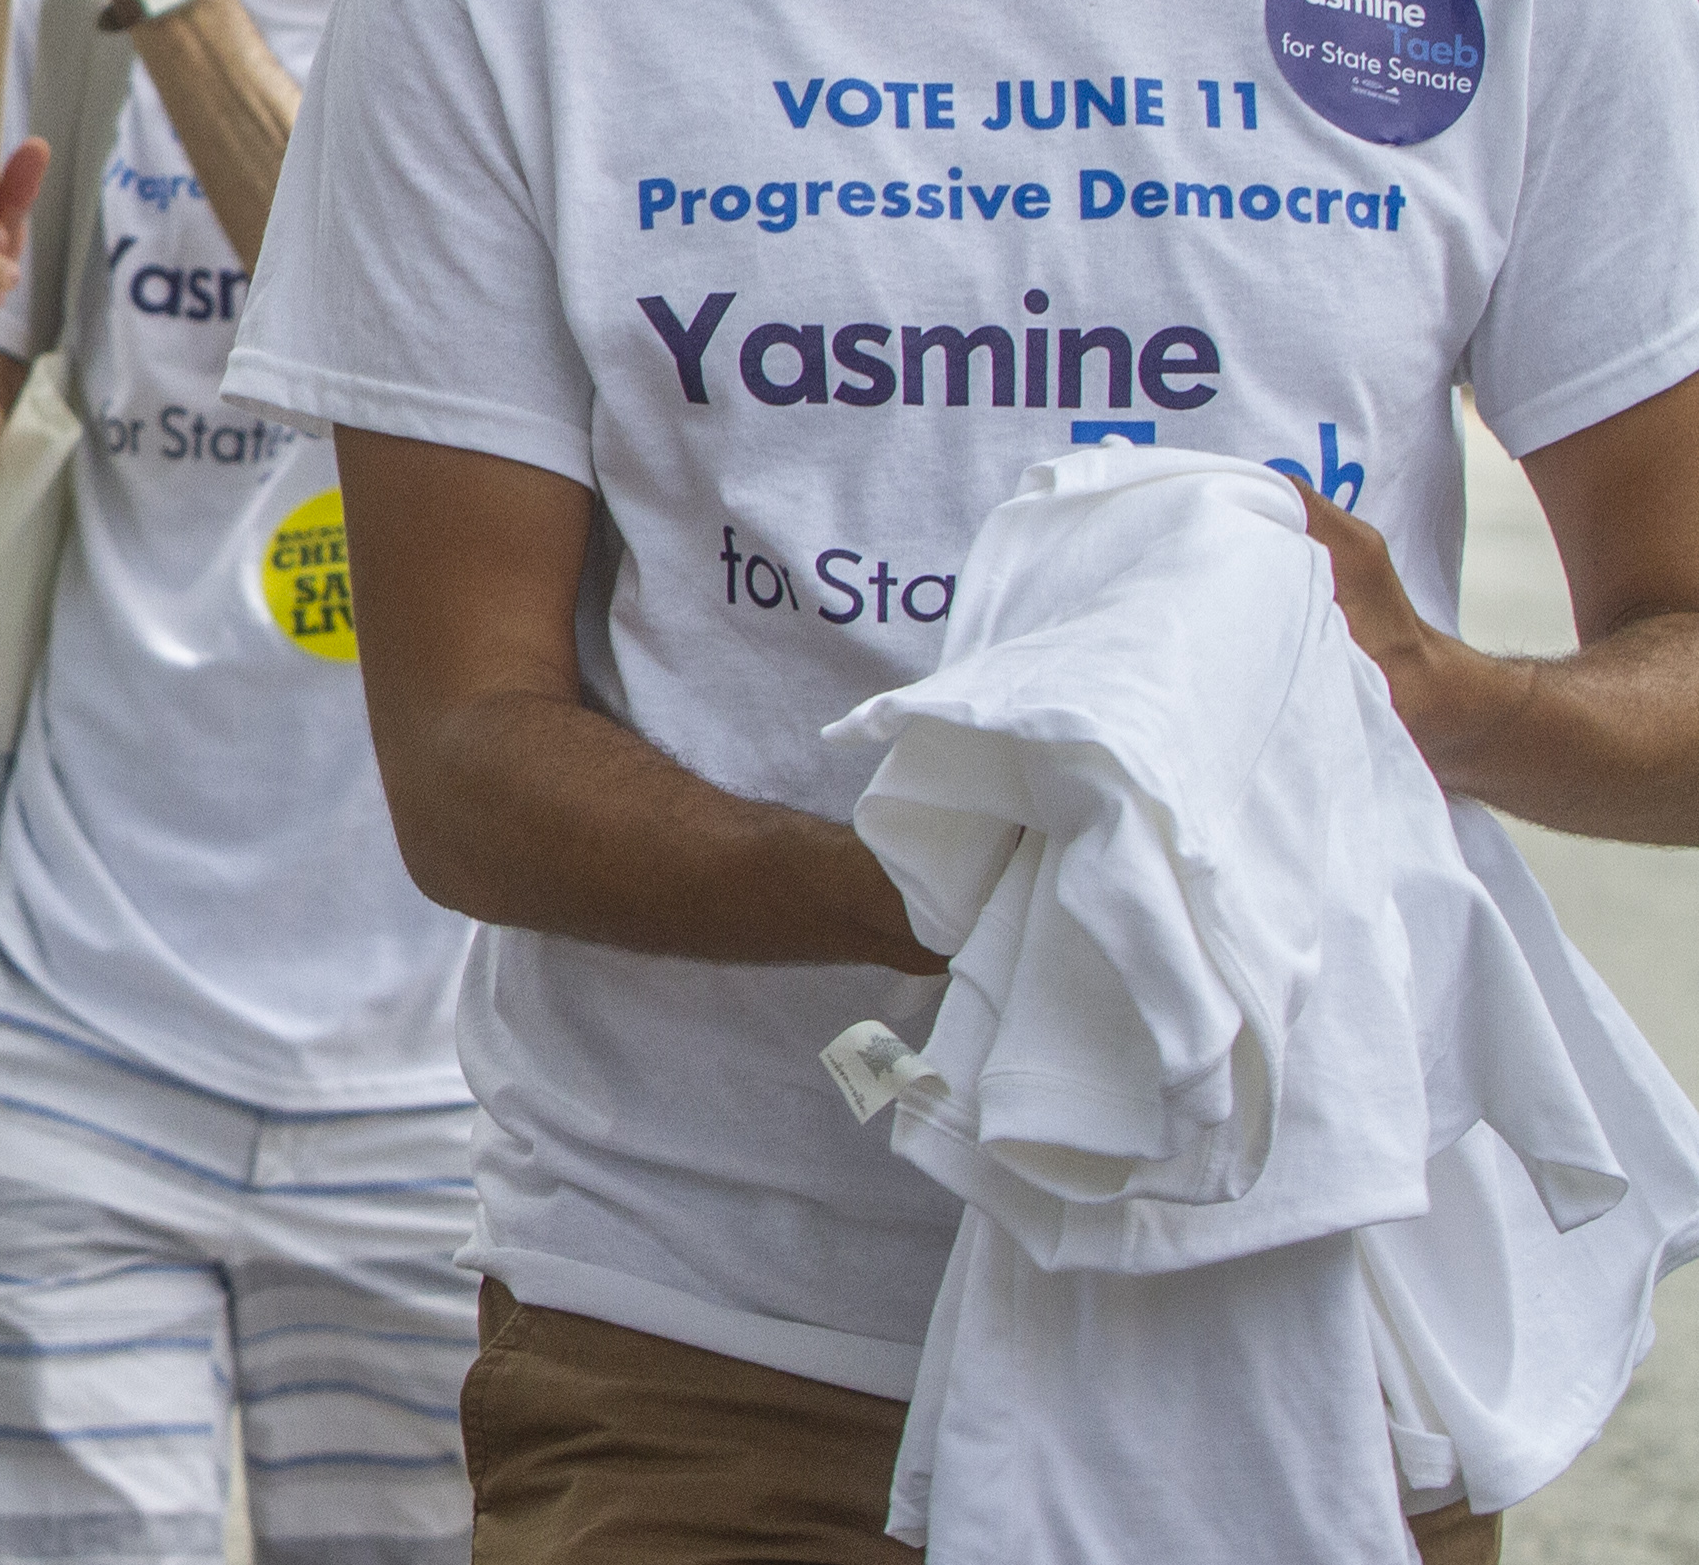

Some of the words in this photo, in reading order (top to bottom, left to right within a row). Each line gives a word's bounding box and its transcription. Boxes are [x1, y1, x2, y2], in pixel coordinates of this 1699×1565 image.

[1281, 31, 1314, 59] for
[1320, 40, 1381, 75] State
[1387, 56, 1472, 94] Senate
[1386, 22, 1479, 69] Taeb
[772, 77, 955, 130] VOTE
[981, 77, 1166, 131] JUNE
[1198, 79, 1258, 130] 11
[637, 166, 1051, 233] Progressive
[1078, 167, 1405, 232] Democrat
[636, 288, 1222, 411] Yasmine
[815, 546, 957, 626] Sta
